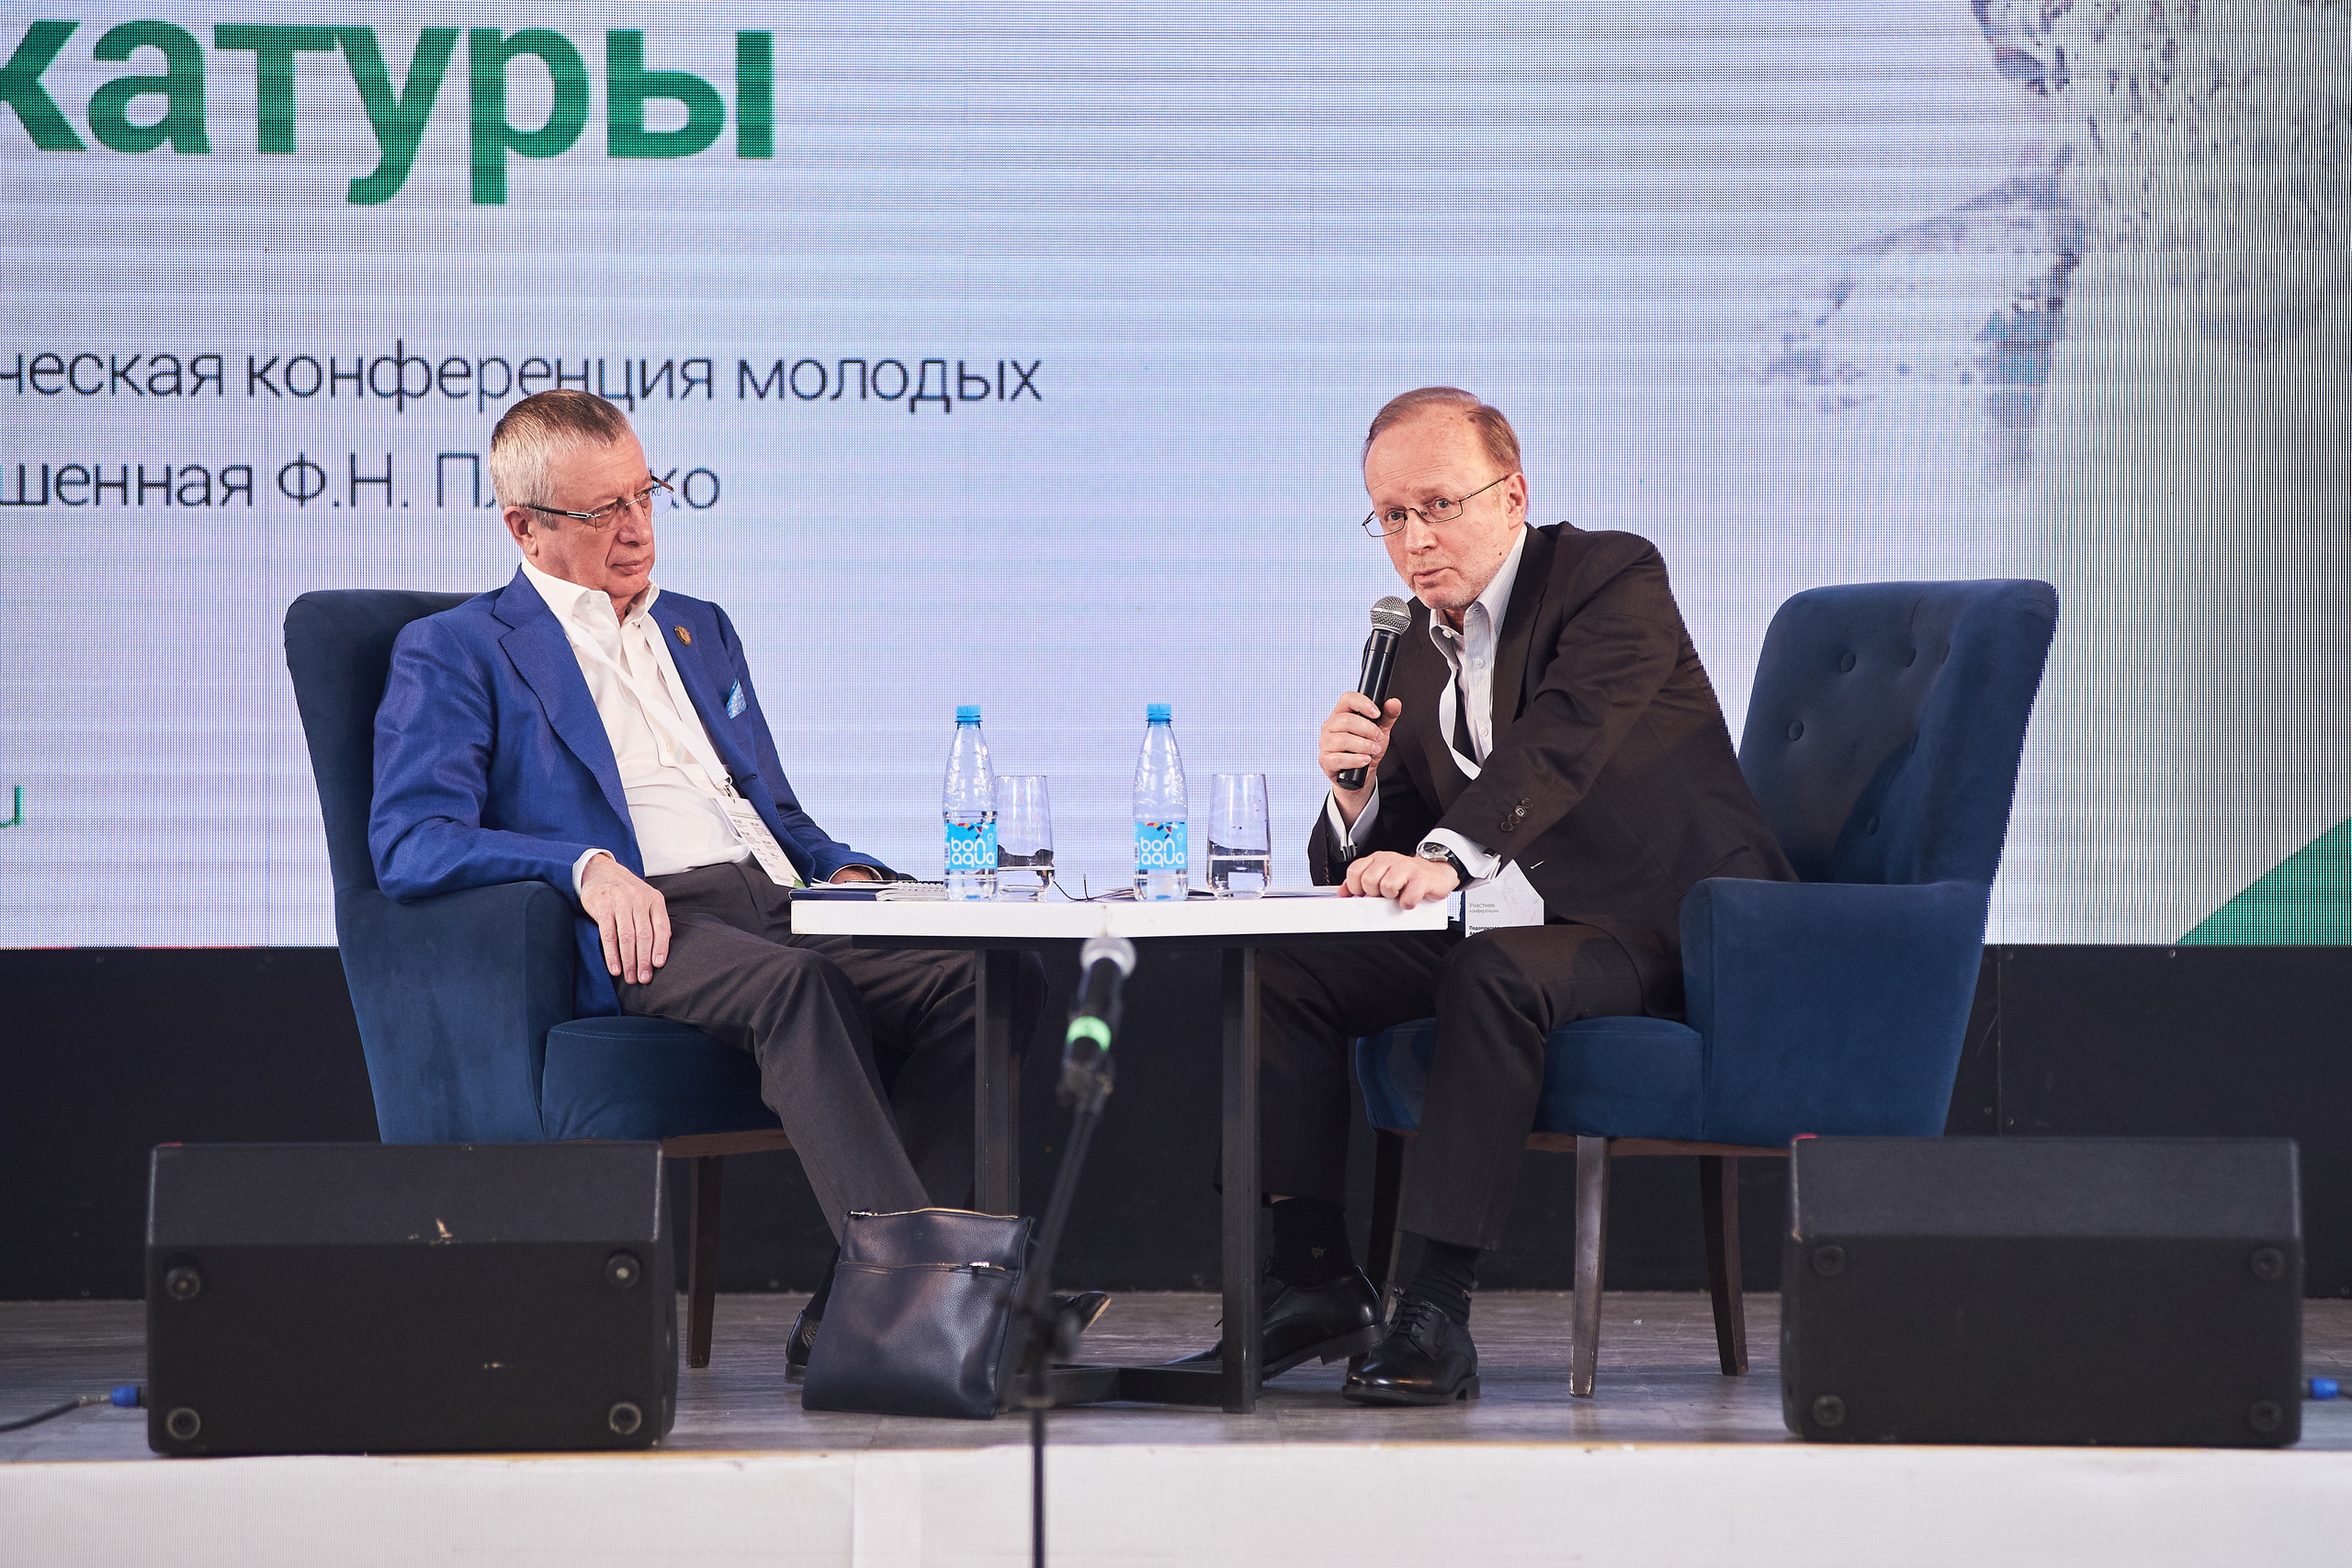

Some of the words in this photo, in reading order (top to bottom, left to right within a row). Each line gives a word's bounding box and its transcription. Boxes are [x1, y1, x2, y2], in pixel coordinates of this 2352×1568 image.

[249, 338, 713, 413] конференция
[738, 358, 1042, 414] молодых
[277, 451, 409, 508] Ф.Н.
